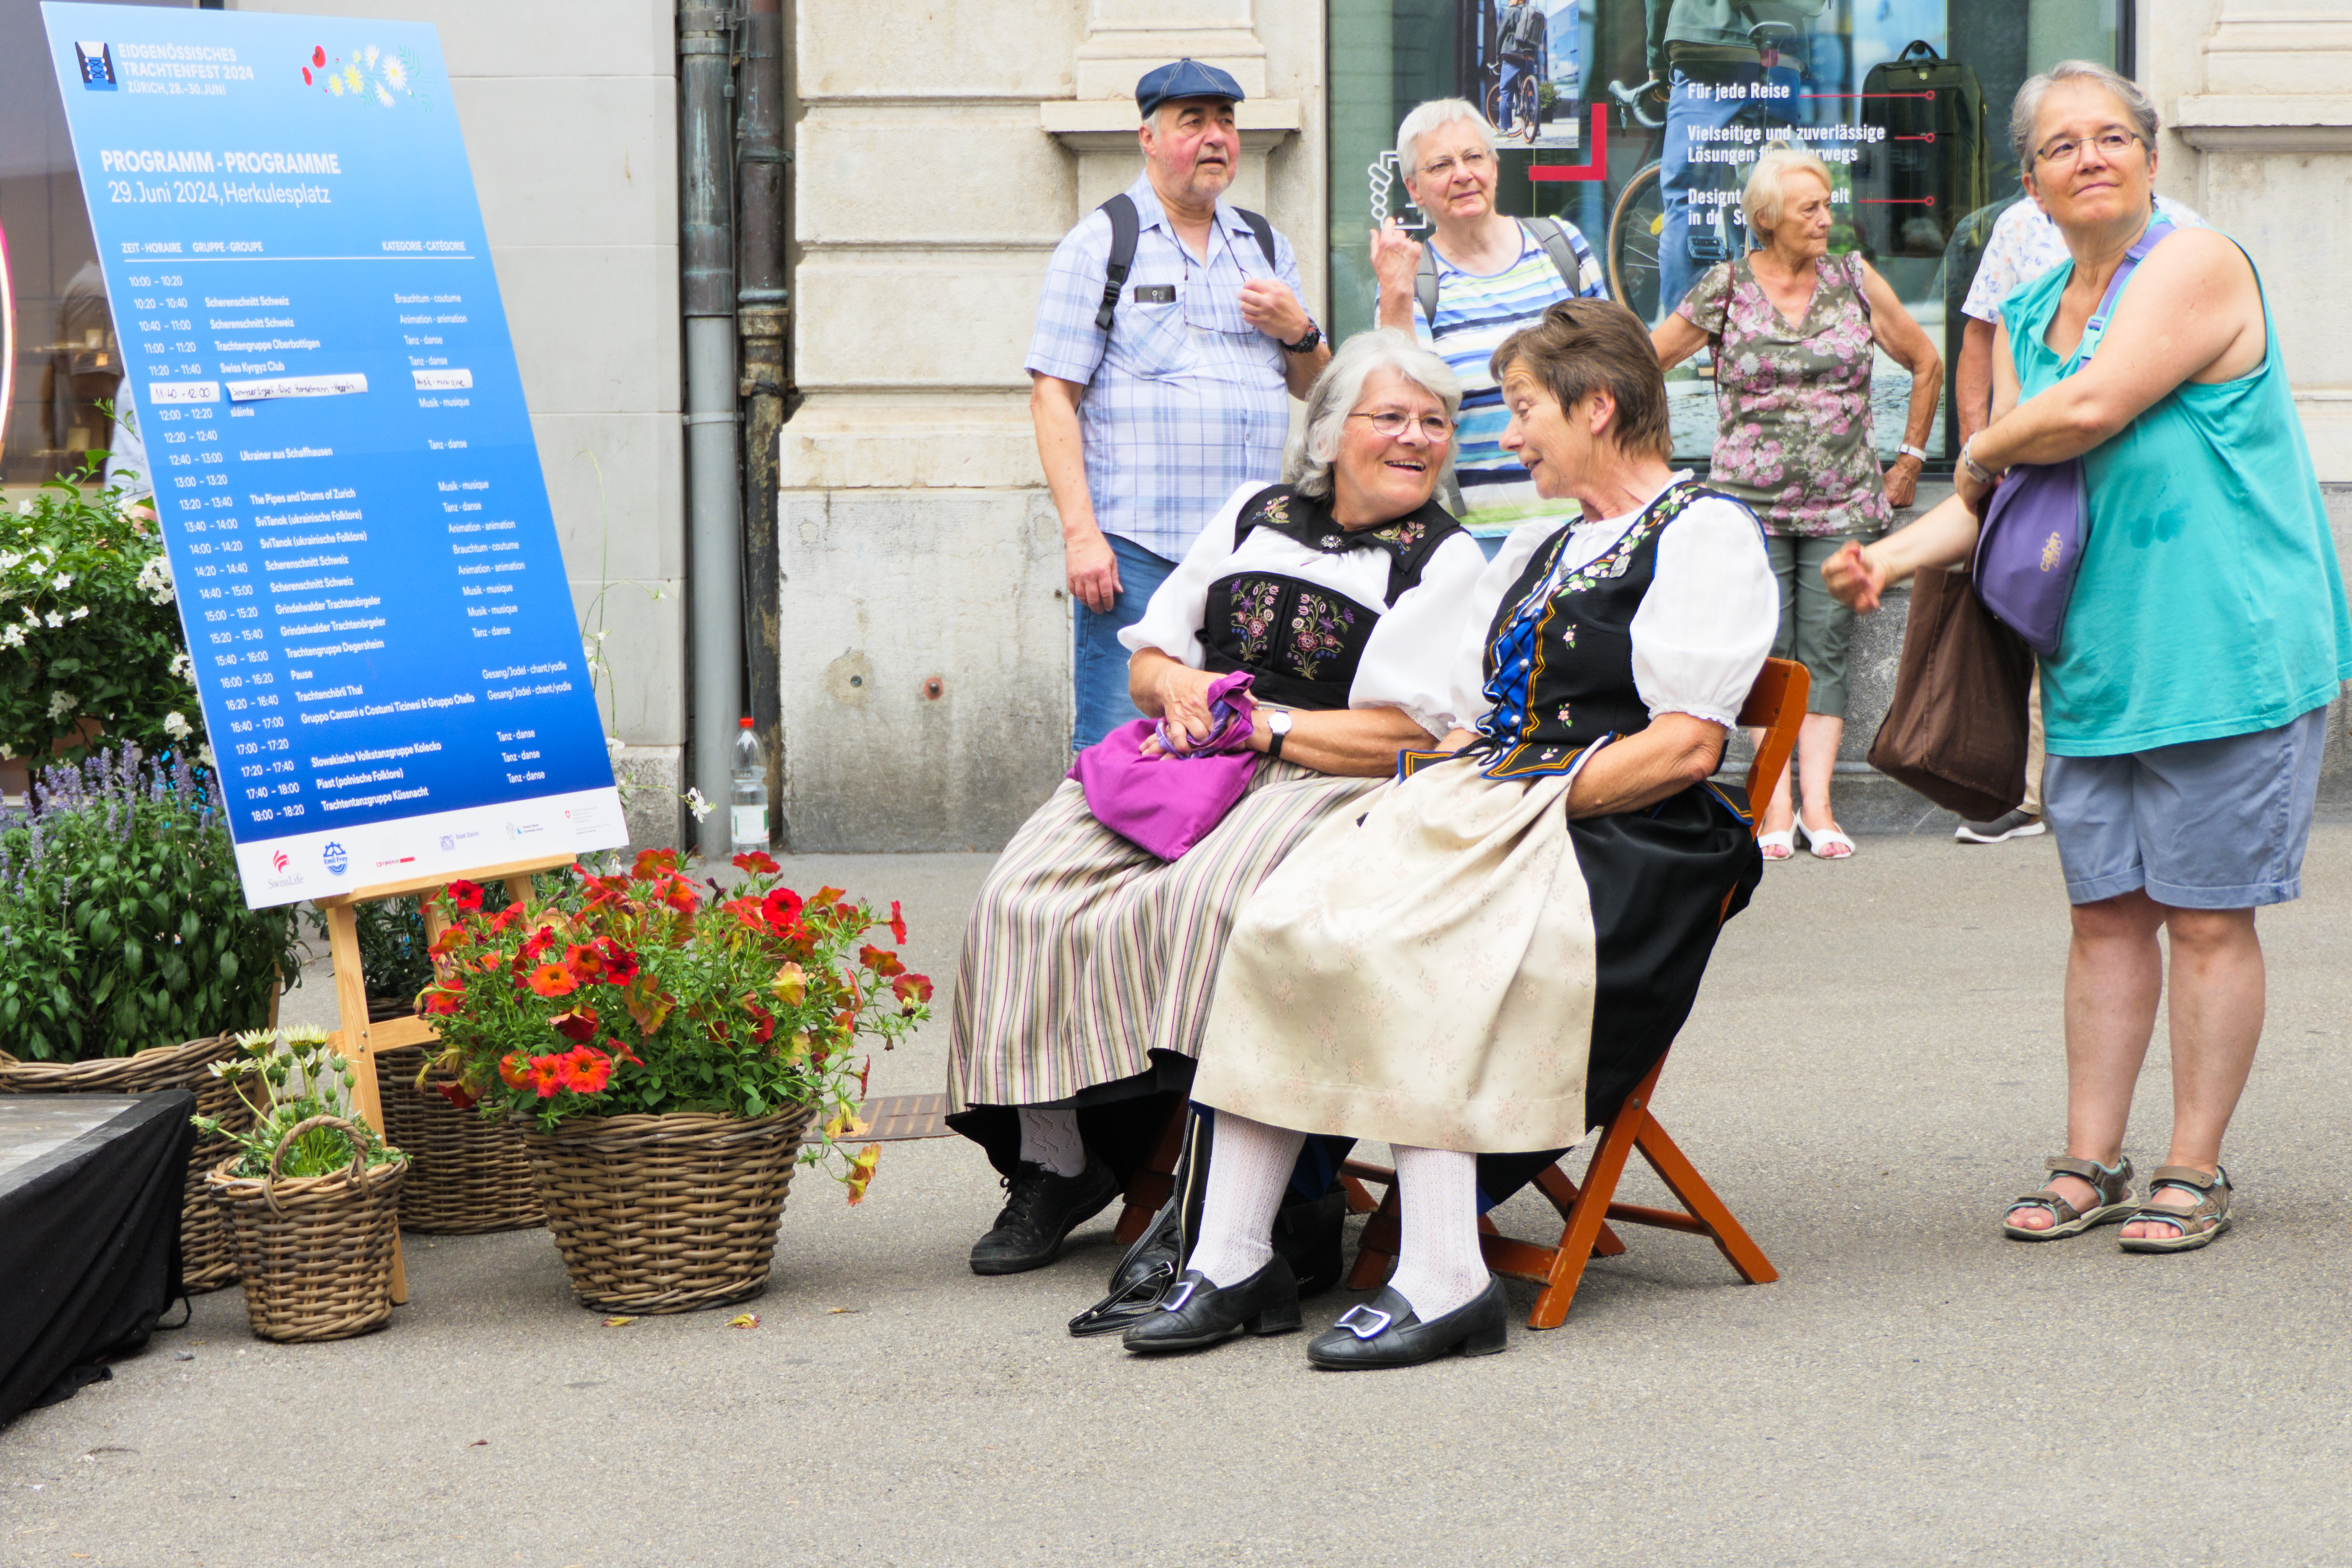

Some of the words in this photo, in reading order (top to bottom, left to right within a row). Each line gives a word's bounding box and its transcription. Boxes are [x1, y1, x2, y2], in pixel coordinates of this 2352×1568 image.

[118, 43, 237, 62] EIDGENÖSSISCHES
[122, 62, 220, 79] TRACHTENFEST
[223, 66, 254, 80] 2024
[1688, 83, 1712, 99] Für
[1715, 82, 1746, 102] jede
[1750, 82, 1790, 99] Reise
[1687, 125, 1762, 144] Vielseitige
[1766, 124, 1791, 141] und
[1796, 124, 1886, 143] zuverlässige
[101, 151, 214, 172] PROGRAMM
[225, 152, 341, 174] PROGRAMME
[1688, 146, 1754, 165] Lösungen
[1688, 188, 1741, 207] Designt
[1688, 209, 1701, 225] in
[1706, 209, 1724, 225] de
[122, 243, 139, 254] ZEIT
[145, 243, 183, 253] HORAIRE
[193, 242, 226, 253] GRUPPE
[230, 241, 264, 252] GROUPE
[382, 241, 423, 251] KATEGORIE
[426, 240, 466, 251] CATÉGORIE
[129, 276, 152, 287] 10:00
[161, 276, 183, 287] 10:20
[134, 298, 157, 310] 10:20
[166, 298, 188, 309] 10:40
[205, 296, 260, 308] Scherenschnitt
[259, 296, 290, 306] Schweiz
[394, 293, 431, 304] Brauchtum
[433, 294, 462, 303] coutume
[139, 320, 161, 332] 10:40
[171, 319, 192, 330] 11:00
[210, 318, 265, 330] Scherenschnitt
[264, 318, 295, 328] Schweiz
[400, 314, 433, 324] Animation
[436, 314, 468, 324] animation
[144, 343, 165, 354] 11:00
[176, 342, 197, 353] 11:20
[214, 340, 273, 353] Trachtengruppe
[272, 338, 321, 351] Oberbottigen
[403, 335, 420, 346] Tanz
[423, 335, 444, 345] danse
[149, 365, 170, 376] 11:20
[181, 363, 202, 375] 11:40
[220, 362, 242, 374] Swiss
[241, 362, 268, 375] Kyrgyz
[267, 361, 286, 372] Club
[418, 398, 440, 408] Musik
[443, 397, 470, 408] musique
[159, 409, 181, 421] 12:00
[191, 408, 213, 419] 12:20
[428, 440, 445, 450] Tanz
[447, 438, 468, 449] danse
[169, 454, 192, 466] 12:40
[201, 452, 223, 464] 13:00
[240, 450, 272, 461] Ukrainer
[272, 451, 286, 460] aus
[285, 446, 334, 459] Schaffhausen
[174, 477, 197, 488] 13:00
[206, 474, 228, 486] 13:20
[179, 498, 202, 510] 13:20
[211, 496, 233, 508] 13:40
[249, 494, 265, 505] The
[264, 493, 287, 505] Pipes
[286, 492, 301, 503] and
[300, 491, 325, 502] Drums
[324, 489, 333, 500] of
[333, 488, 357, 500] Zurich
[288, 512, 332, 526] (ukrainische
[331, 509, 363, 521] Folklore)
[184, 521, 207, 533] 13:40
[216, 519, 239, 530] 14:00
[452, 543, 489, 554] Brauchtum
[492, 542, 520, 551] coutume
[2040, 531, 2060, 572] cabin
[194, 565, 217, 577] 14:20
[226, 563, 248, 574] 14:40
[265, 557, 320, 571] Scherenschnitt
[319, 554, 349, 567] Schweiz
[459, 564, 491, 575] Animation
[494, 561, 526, 572] animation
[199, 587, 222, 599] 14:40
[231, 585, 254, 596] 15:00
[462, 585, 483, 596] Musik
[486, 584, 514, 595] musique
[275, 601, 326, 615] Grindelwalder
[325, 595, 381, 610] Trachtenörgeler
[205, 610, 227, 622] 15:00
[236, 606, 259, 618] 15:20
[210, 632, 232, 644] 15:20
[242, 629, 264, 641] 15:40
[284, 645, 343, 659] Trachtengruppe
[342, 639, 385, 653] Degersheim
[215, 654, 237, 666] 15:40
[247, 651, 269, 662] 16:00
[220, 676, 243, 688] 16:00
[252, 673, 274, 685] 16:20
[290, 670, 314, 680] Pause
[295, 686, 348, 702] Trachtenchörli
[346, 684, 363, 696] Thal
[226, 698, 248, 711] 16:20
[257, 694, 279, 707] 16:40
[301, 713, 330, 724] Gruppo
[329, 707, 360, 720] Canzoni
[365, 703, 395, 716] Costumi
[394, 699, 422, 712] Ticinesi
[421, 698, 428, 708] &
[428, 697, 454, 708] Gruppo
[454, 693, 475, 704] Otello
[231, 720, 253, 733] 16:40
[262, 716, 284, 729] 17:00
[496, 731, 514, 742] Tanz
[516, 729, 536, 740] danse
[311, 753, 356, 768] Slowakische
[355, 746, 414, 762] Volkstanzgruppe
[241, 764, 263, 777] 17:20
[273, 760, 295, 773] 17:40
[316, 778, 336, 790] Piast
[335, 773, 373, 789] (polnische
[372, 768, 404, 781] Folklore)
[246, 786, 269, 800] 17:40
[278, 782, 300, 795] 18:00
[321, 794, 393, 811] Trachtentanzgruppe
[392, 786, 430, 801] Küssnacht
[251, 809, 274, 822] 18:00
[283, 804, 305, 817] 18:20
